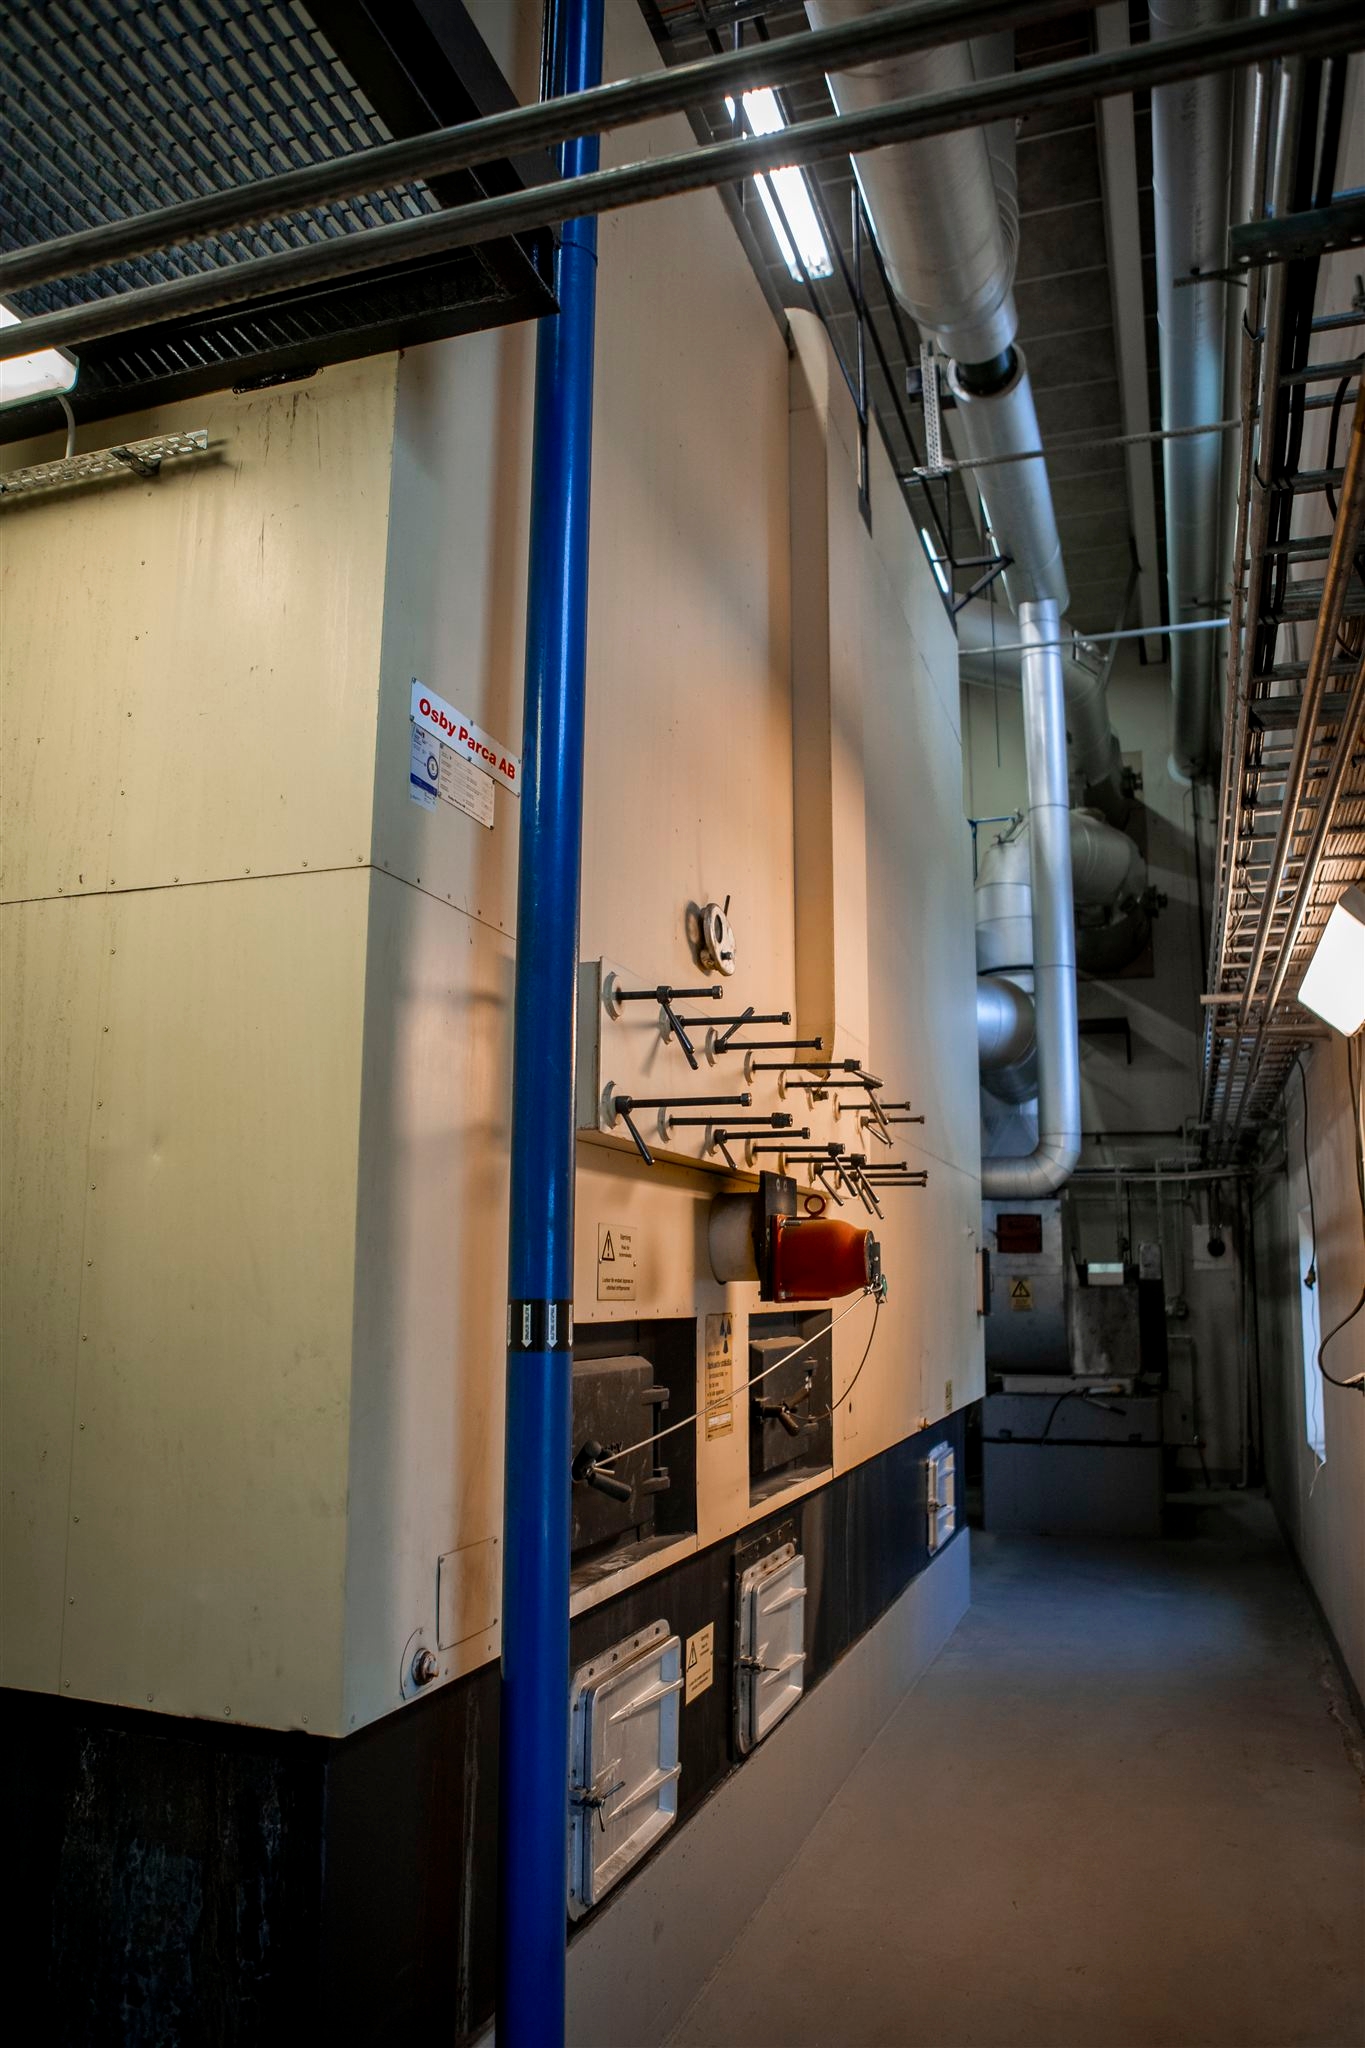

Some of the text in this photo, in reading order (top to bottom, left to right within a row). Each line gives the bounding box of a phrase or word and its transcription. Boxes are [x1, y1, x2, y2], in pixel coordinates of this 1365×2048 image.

[419, 697, 456, 737] Osby
[459, 725, 497, 765] Parca
[499, 758, 516, 780] AB
